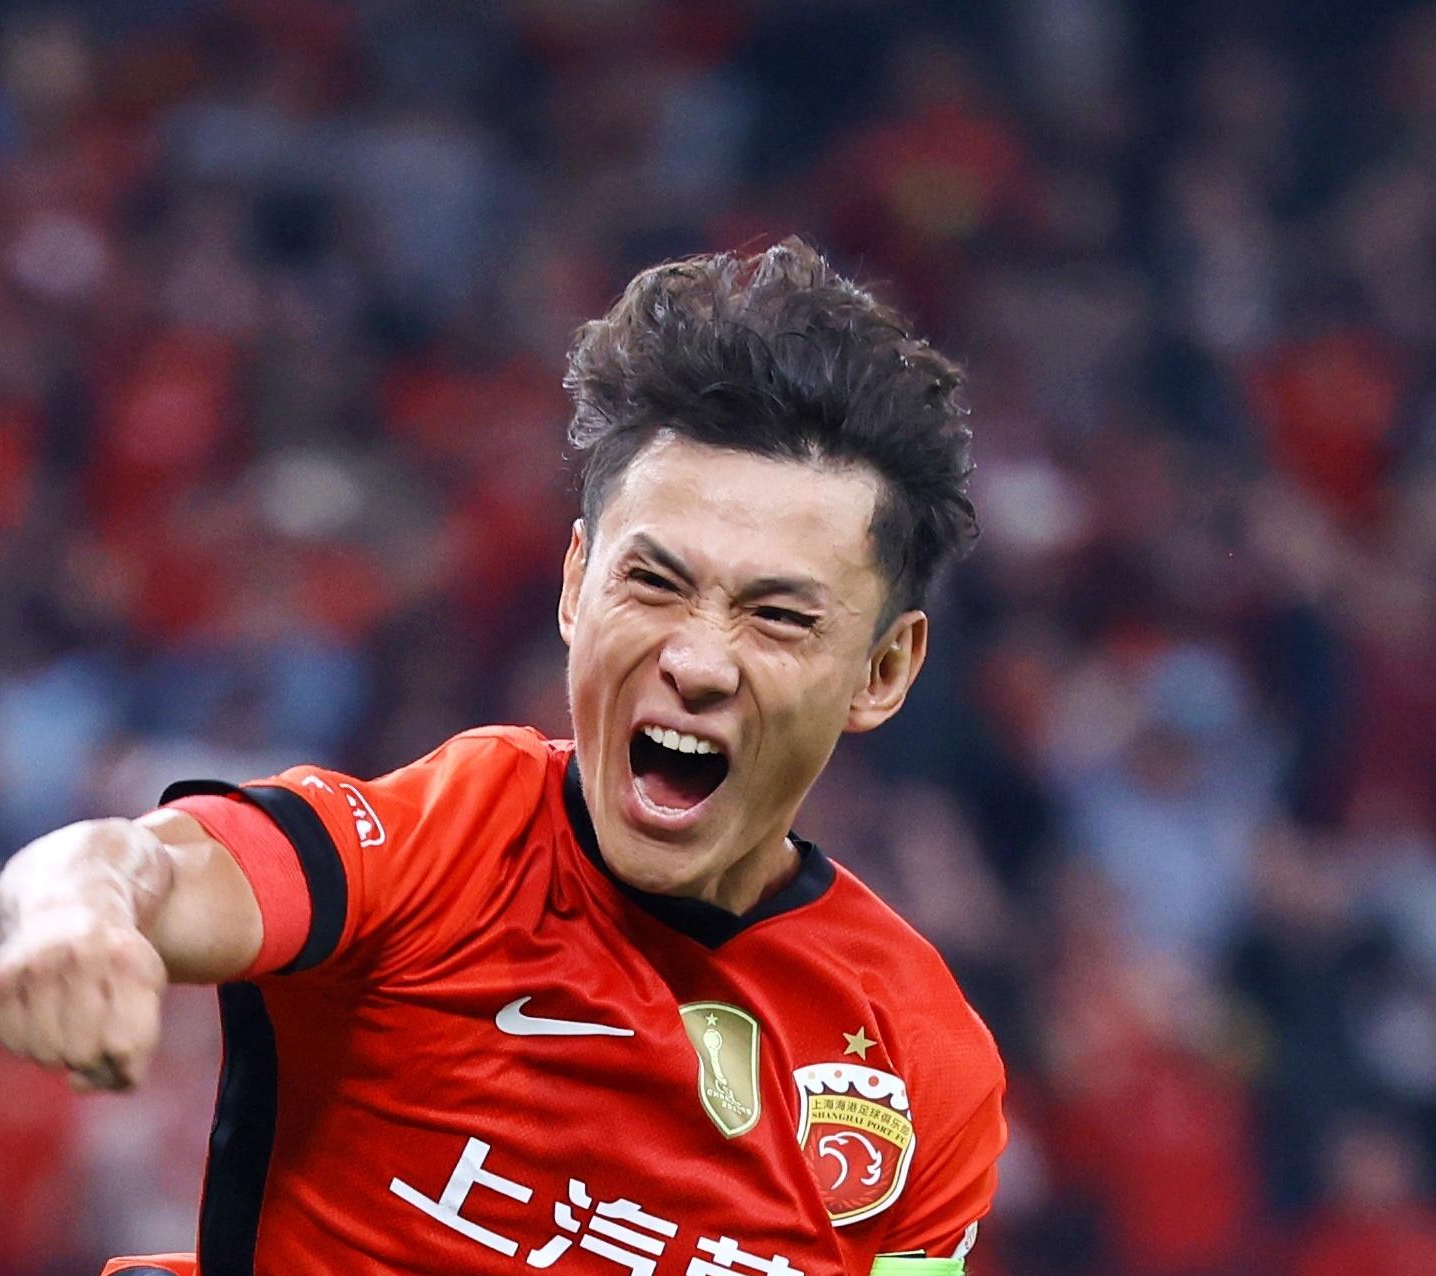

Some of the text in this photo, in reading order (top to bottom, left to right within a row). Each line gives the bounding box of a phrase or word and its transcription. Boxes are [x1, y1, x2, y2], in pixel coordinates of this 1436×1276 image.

[812, 1099, 911, 1136] 上海海港足球俱乐部
[812, 1111, 905, 1144] SHANGHAI PORT FC
